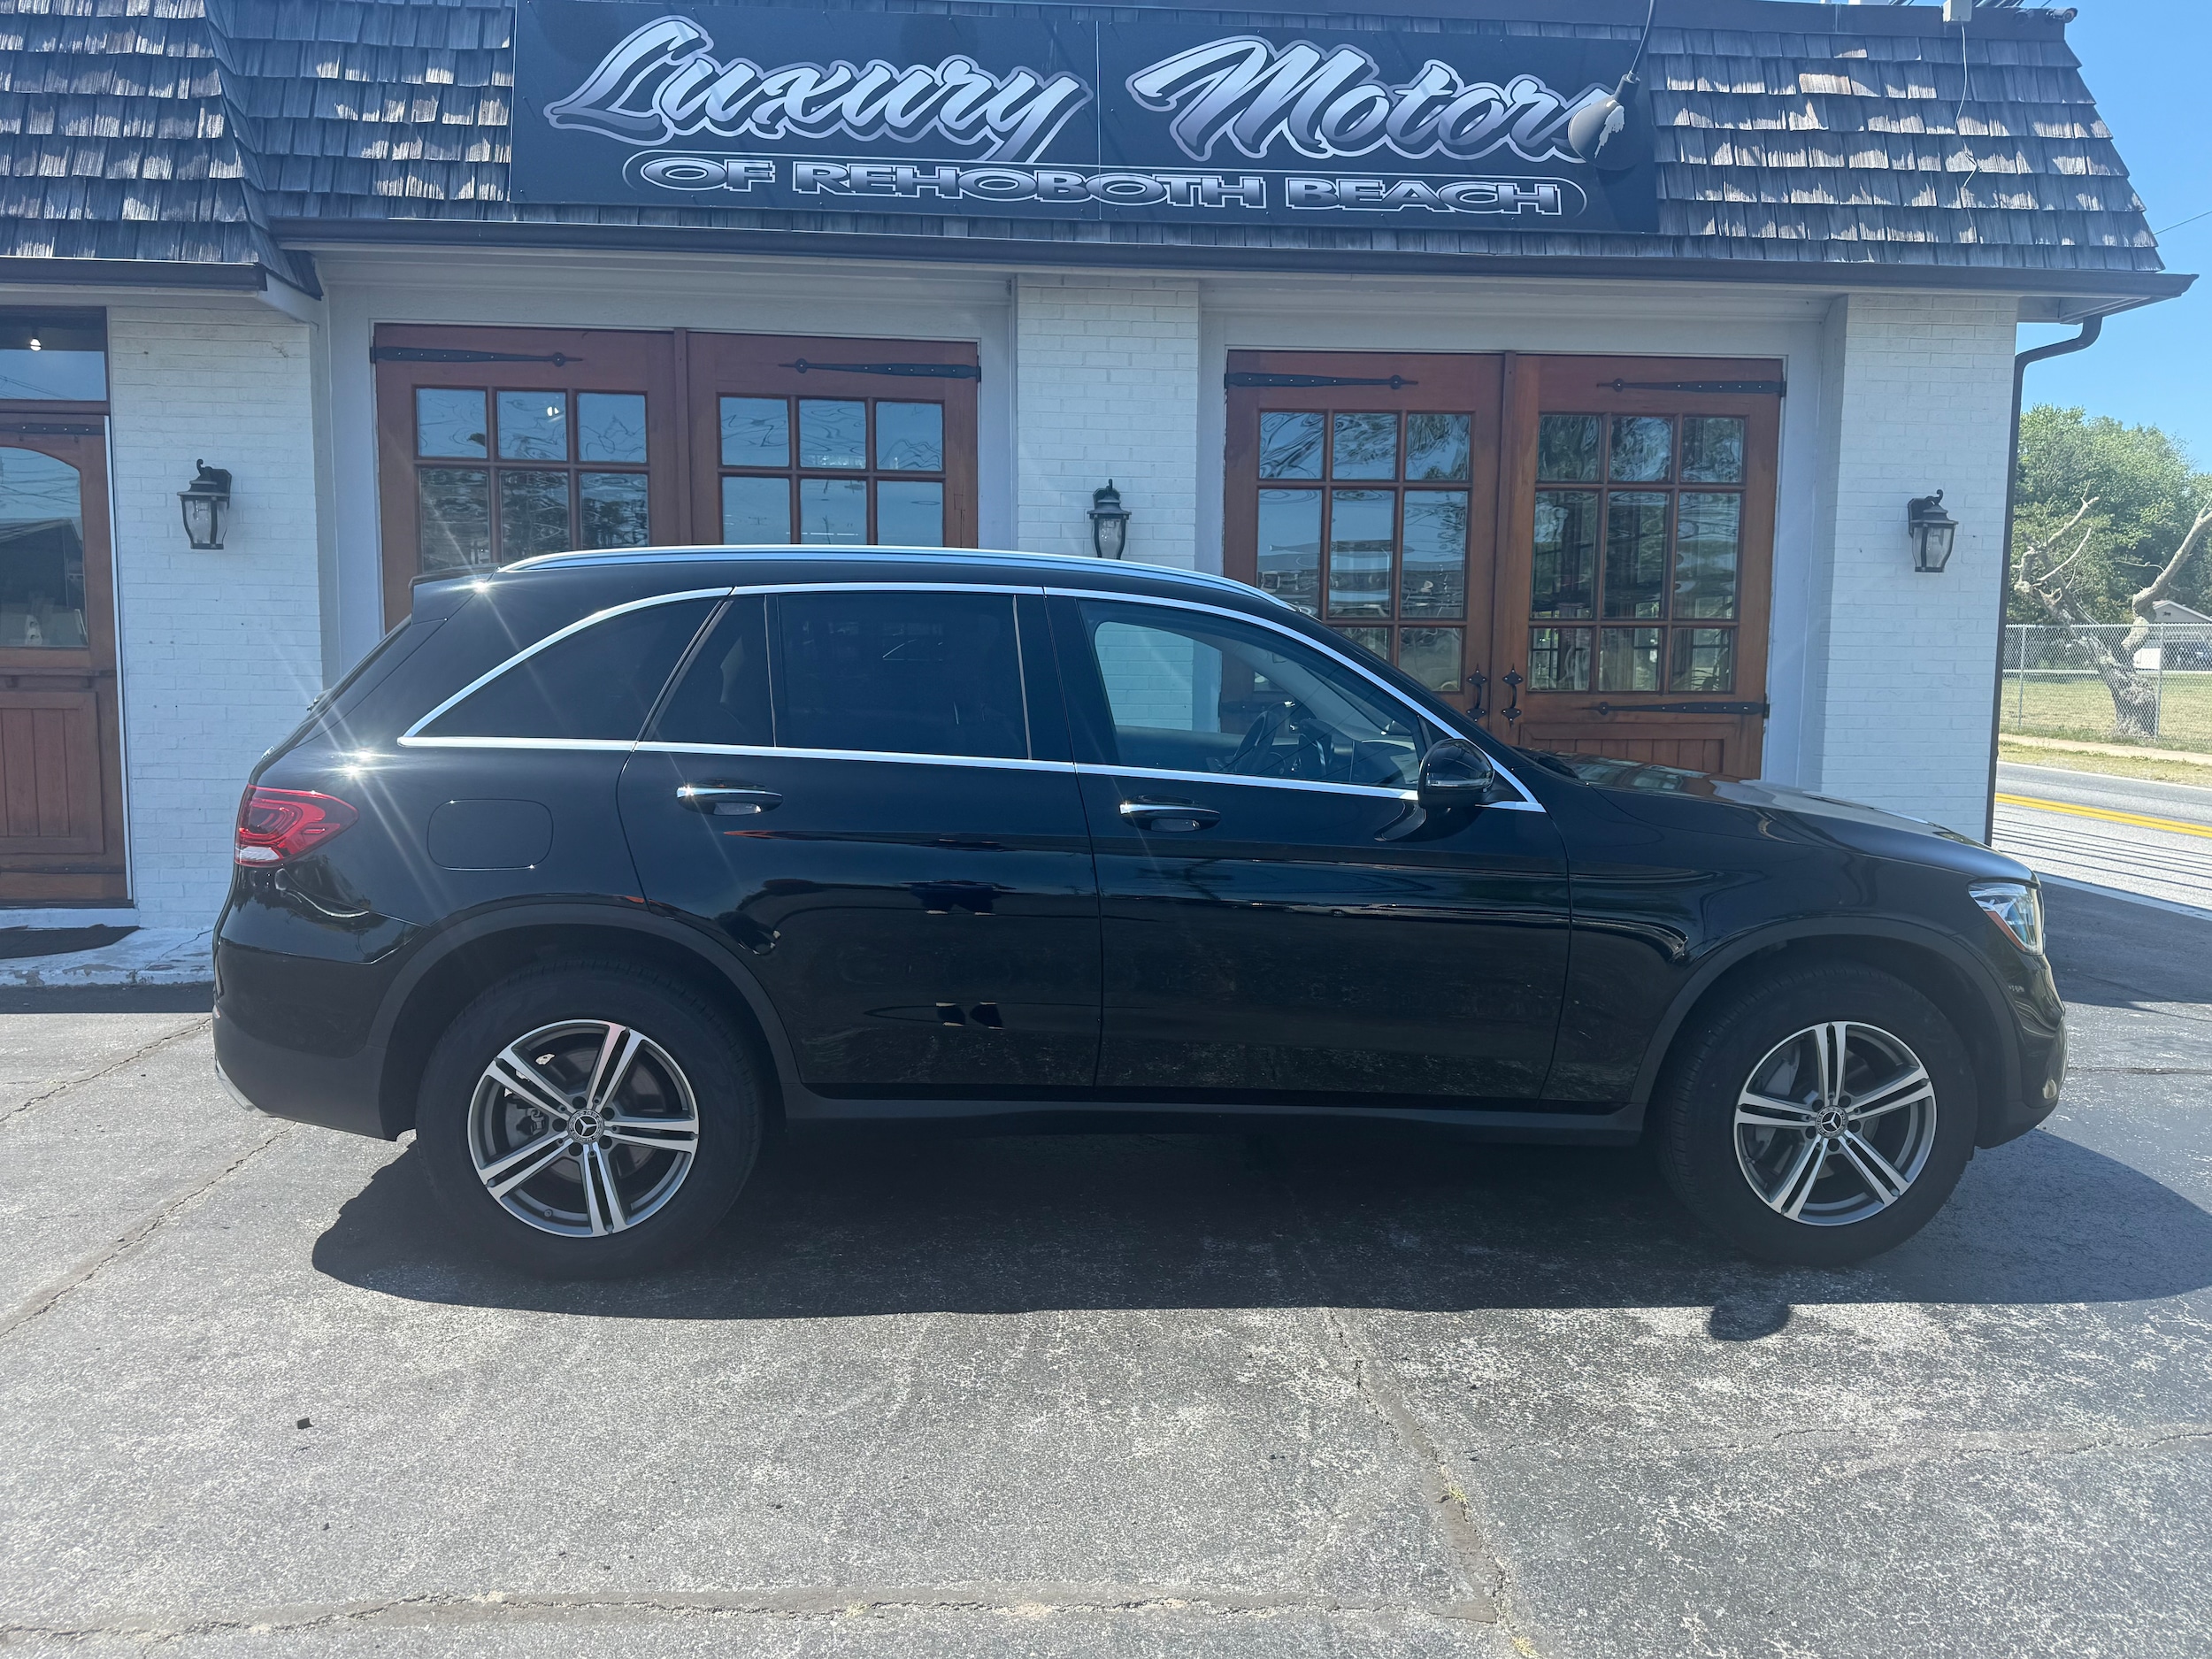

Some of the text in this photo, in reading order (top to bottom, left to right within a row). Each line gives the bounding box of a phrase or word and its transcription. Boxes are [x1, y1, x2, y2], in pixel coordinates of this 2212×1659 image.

[544, 15, 1094, 162] Luxury
[641, 157, 1562, 215] OF REHOBOTH BEACH
